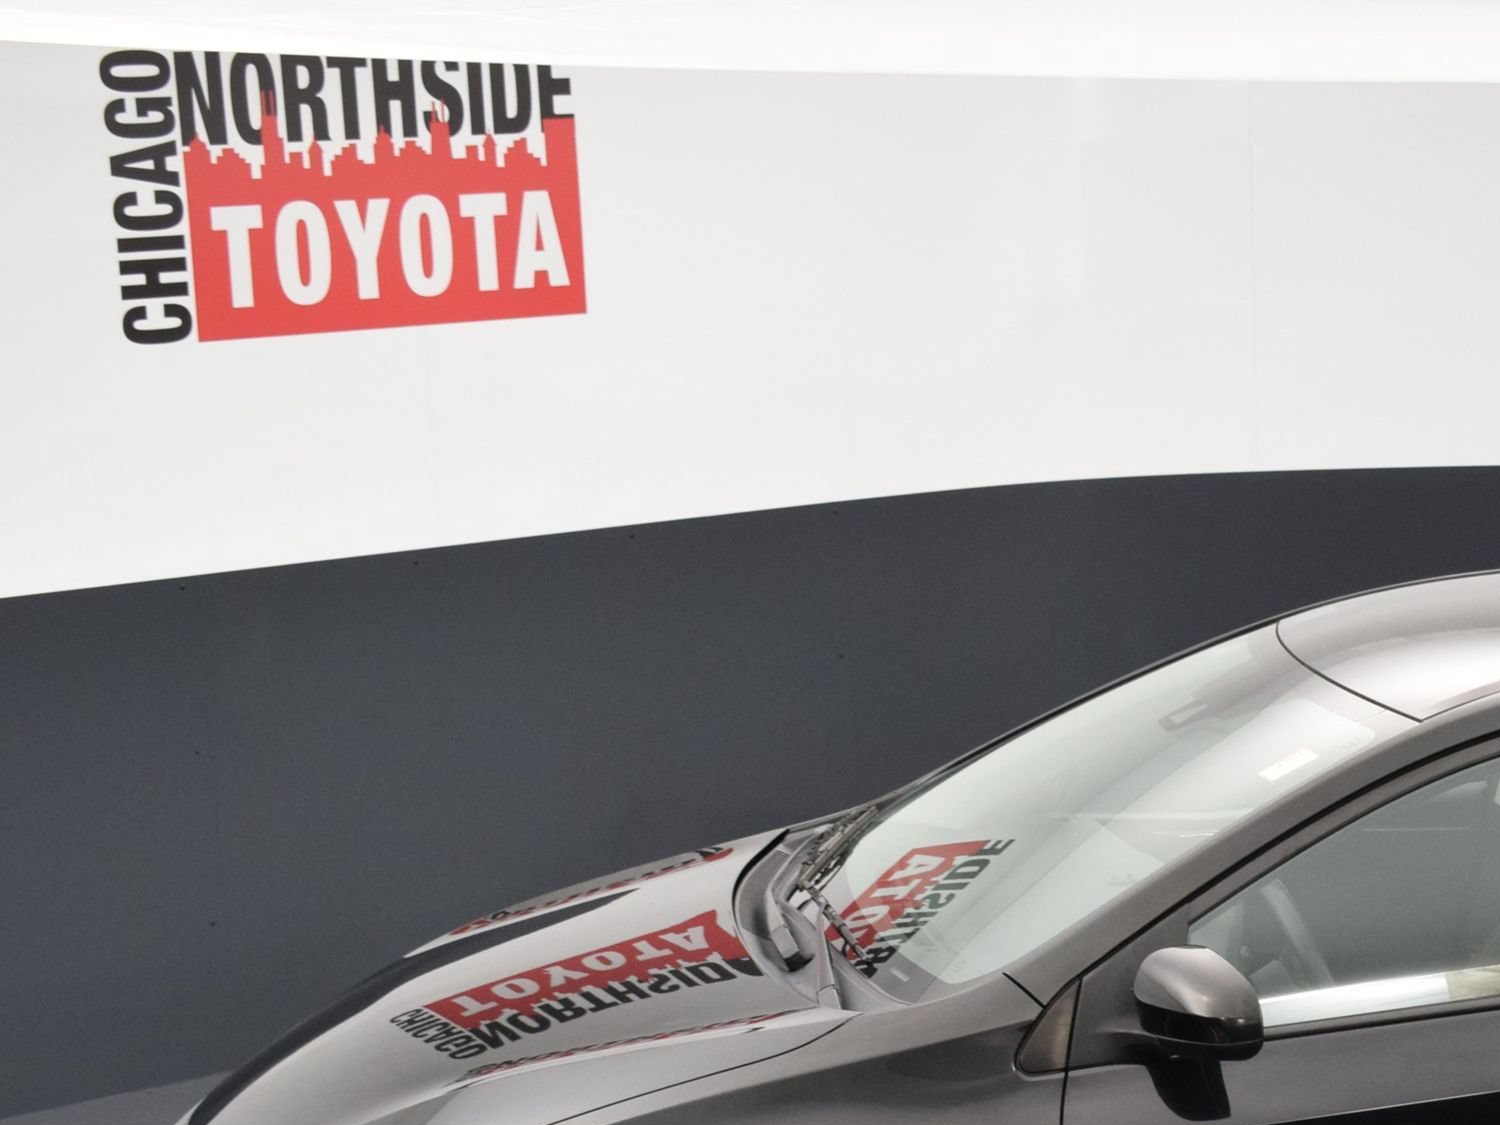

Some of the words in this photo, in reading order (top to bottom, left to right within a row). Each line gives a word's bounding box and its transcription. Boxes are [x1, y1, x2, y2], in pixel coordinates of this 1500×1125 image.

[173, 50, 575, 146] NORTHSIDE
[99, 49, 193, 345] CHICAGO
[210, 190, 571, 309] TOYOTA
